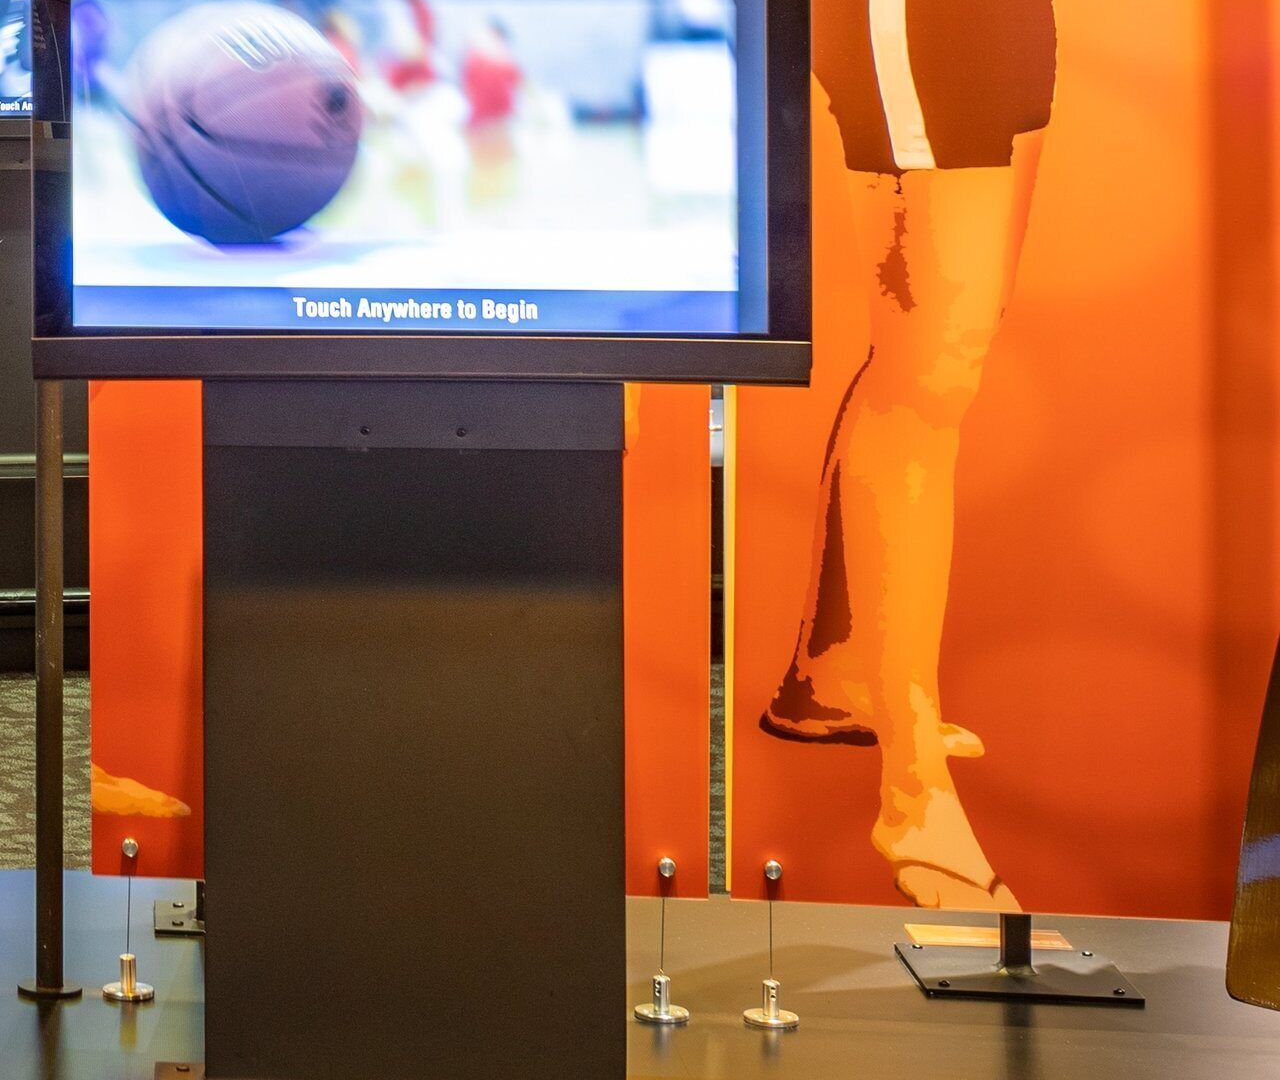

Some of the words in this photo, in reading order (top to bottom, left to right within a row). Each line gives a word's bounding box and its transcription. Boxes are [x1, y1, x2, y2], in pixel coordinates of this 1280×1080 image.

[293, 297, 352, 318] Touch
[357, 298, 453, 323] Anywhere
[458, 299, 477, 319] to
[482, 299, 539, 323] Begin
